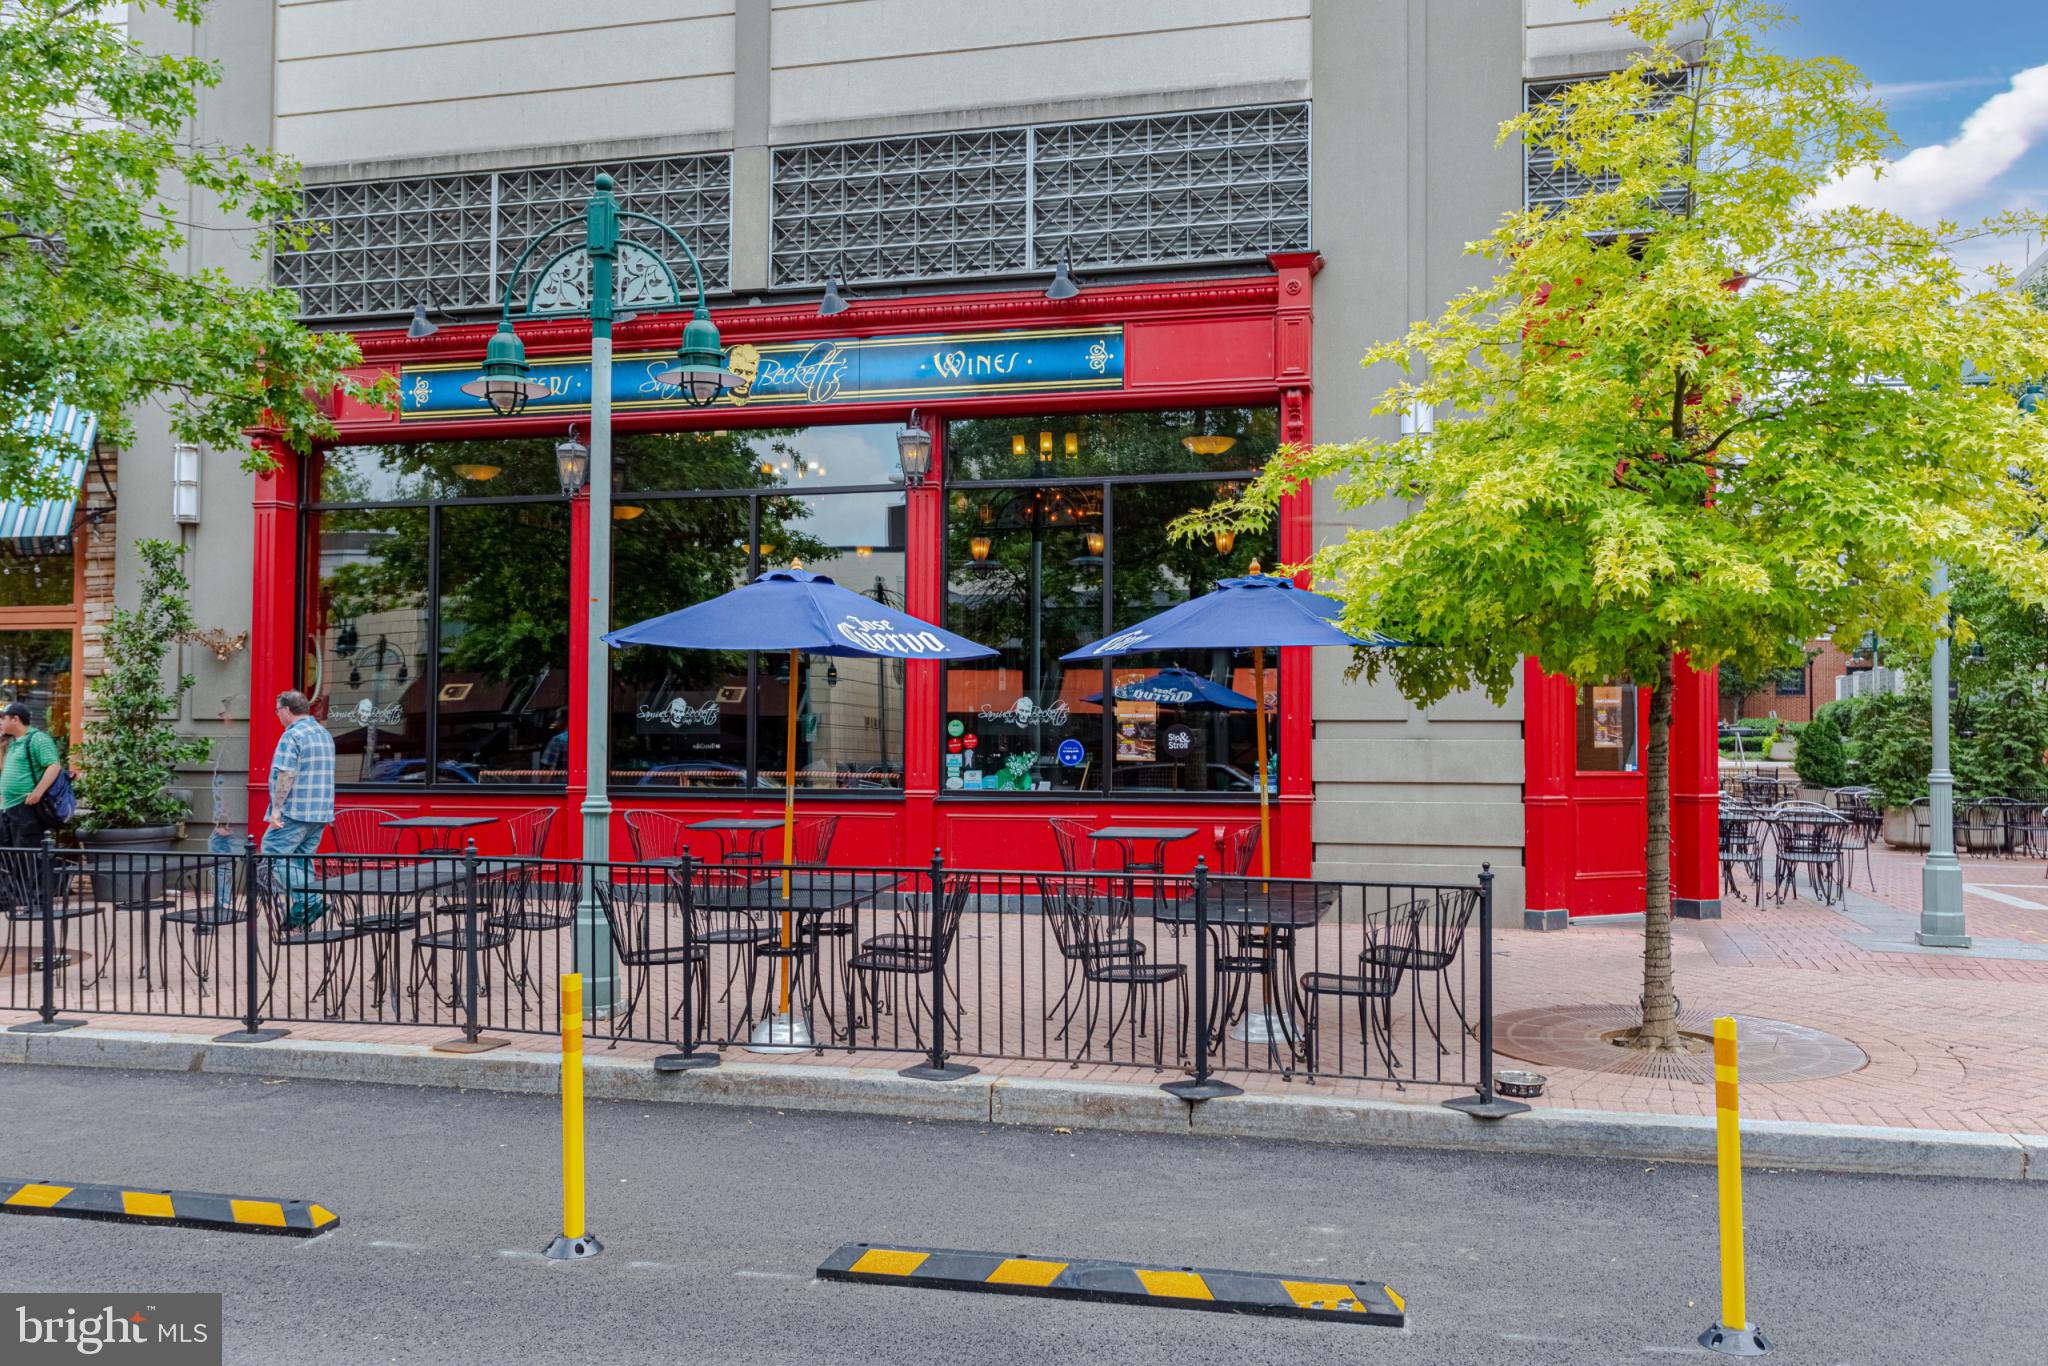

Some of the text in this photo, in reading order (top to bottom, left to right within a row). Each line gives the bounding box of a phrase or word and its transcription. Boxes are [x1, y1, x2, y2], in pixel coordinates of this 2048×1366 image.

[759, 341, 848, 403] Beckett's
[933, 350, 1020, 379] WINES
[846, 615, 894, 632] Jose
[837, 622, 946, 653] Cuervo
[637, 702, 672, 722] Samuel
[977, 698, 1018, 722] Samuel
[1167, 742, 1189, 750] Stroll
